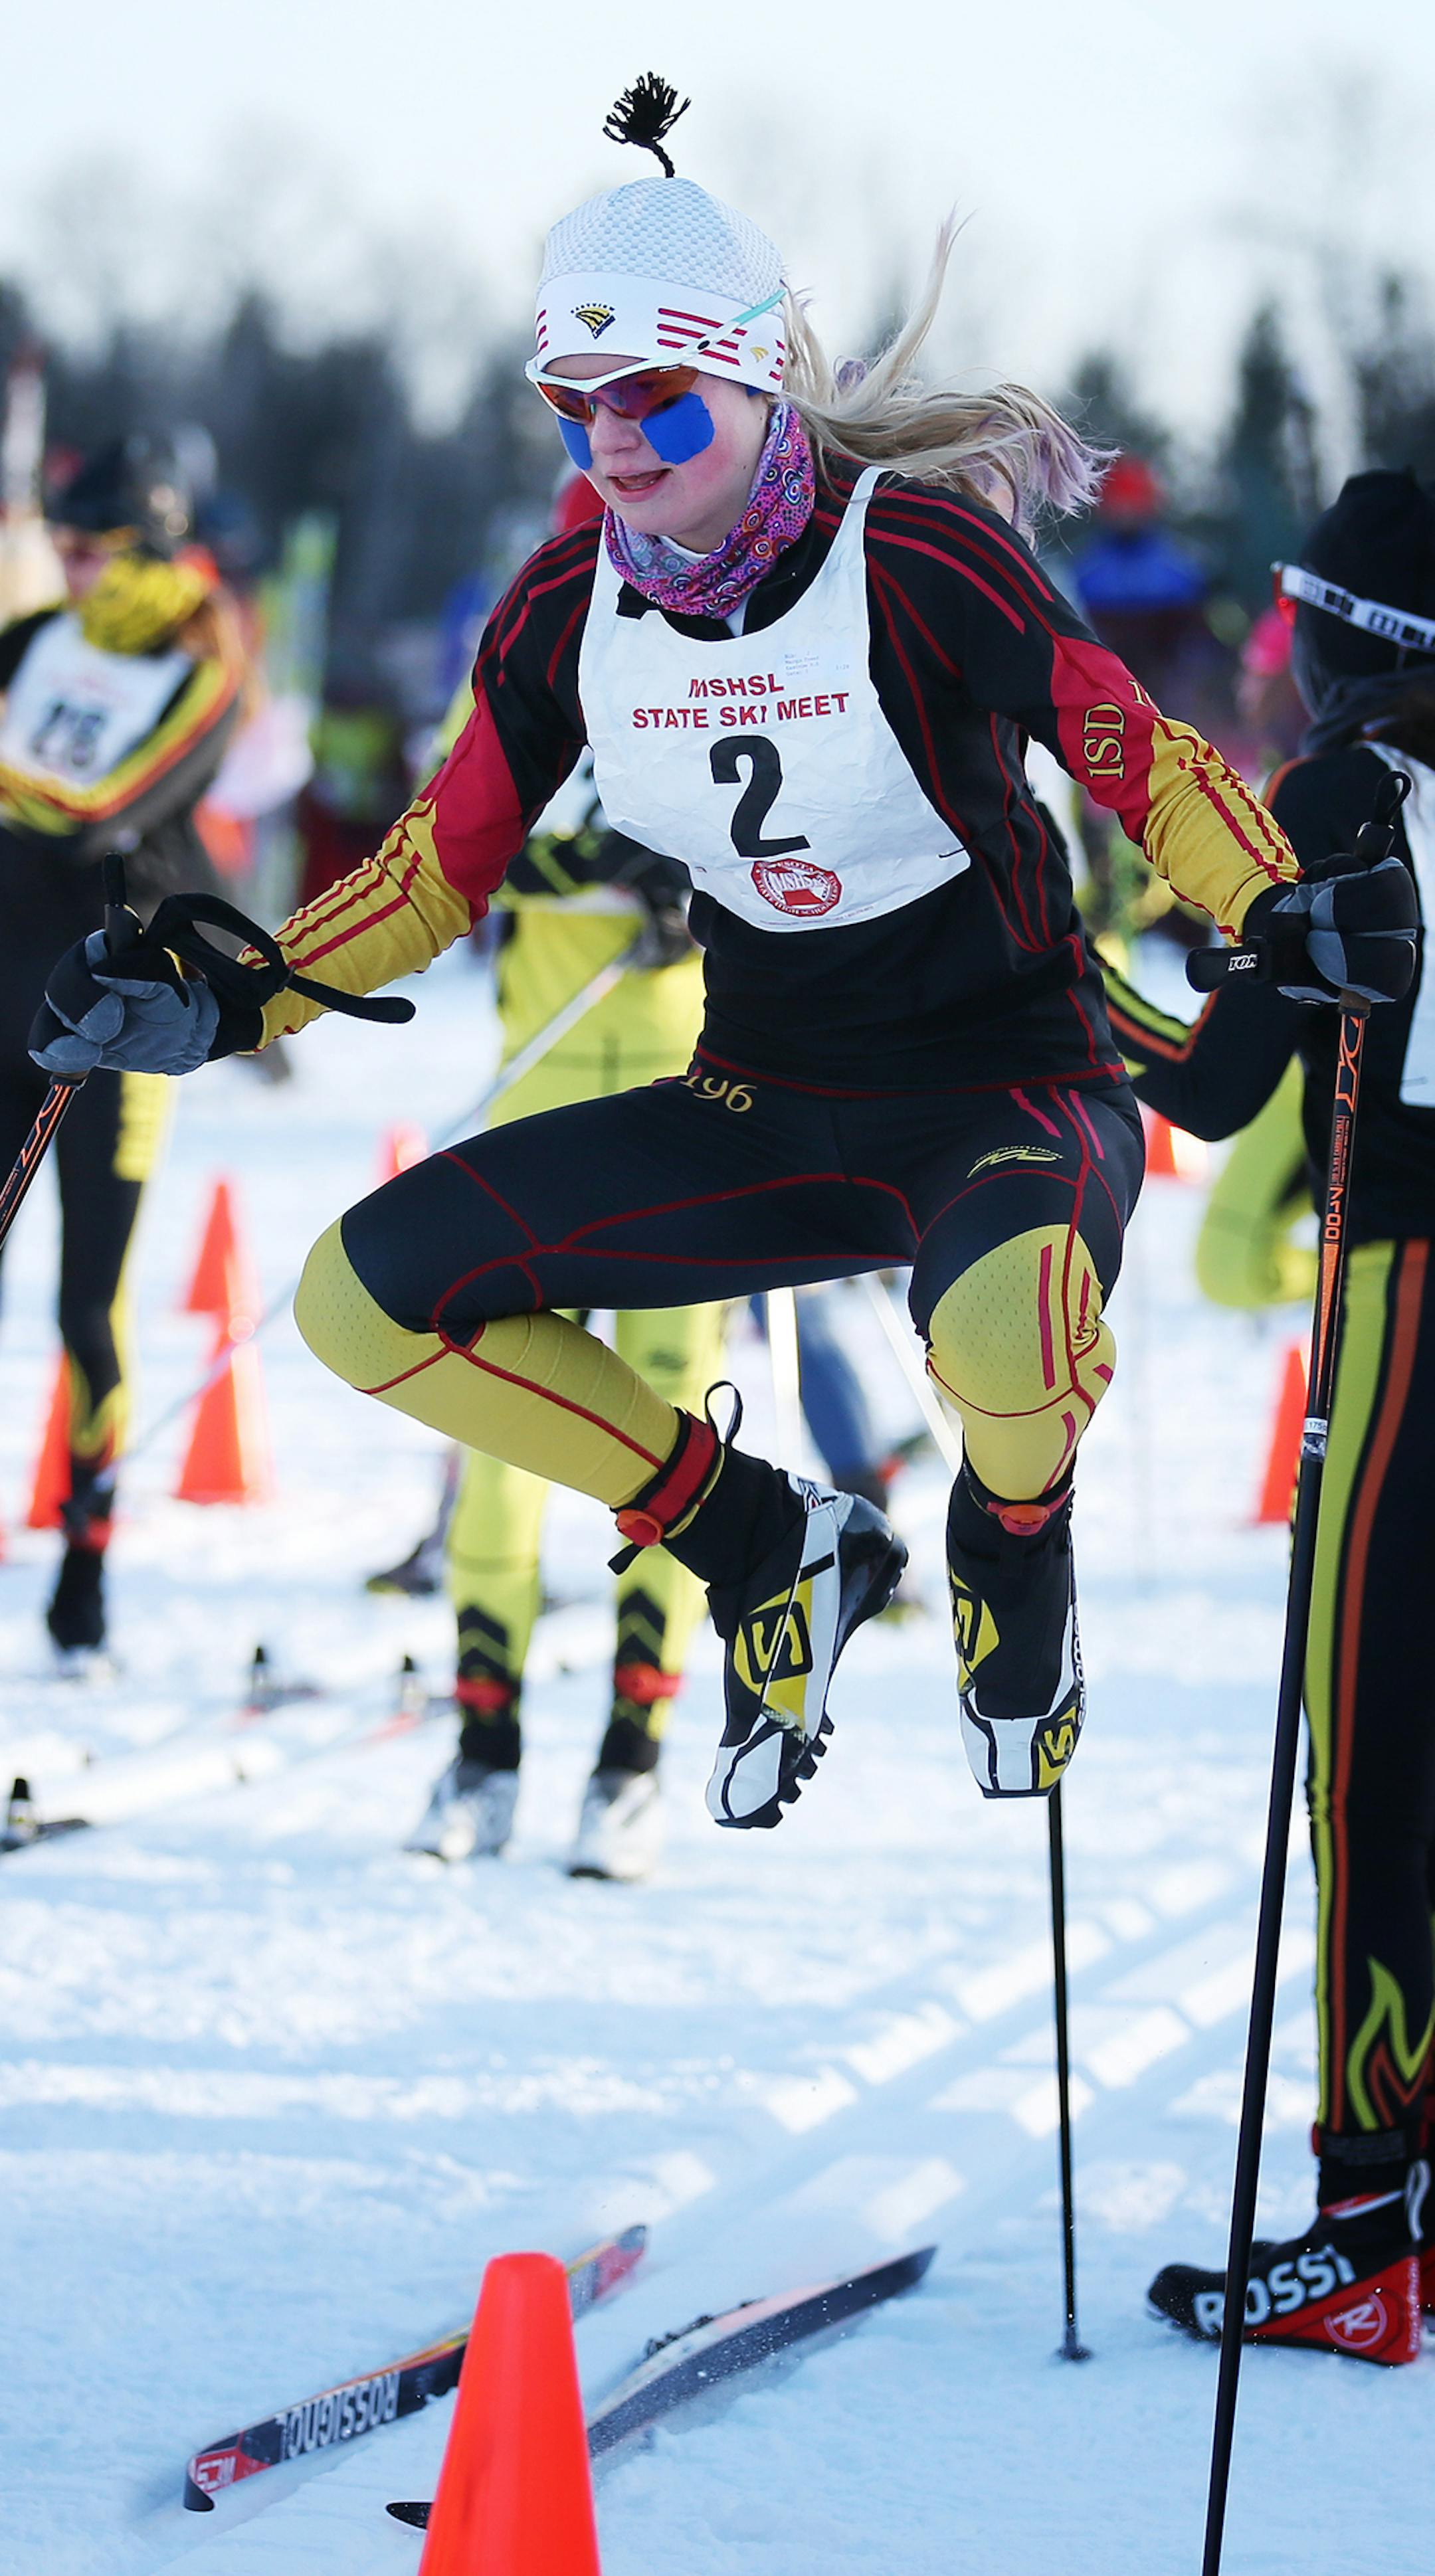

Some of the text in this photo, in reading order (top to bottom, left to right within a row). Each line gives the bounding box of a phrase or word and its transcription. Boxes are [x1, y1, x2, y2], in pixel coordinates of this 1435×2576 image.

[632, 692, 850, 729] STATE SKI MEET
[688, 673, 785, 698] MSHSL
[1083, 703, 1125, 780] ISD
[710, 735, 811, 858] 2
[1194, 2243, 1356, 2334] ROSSI
